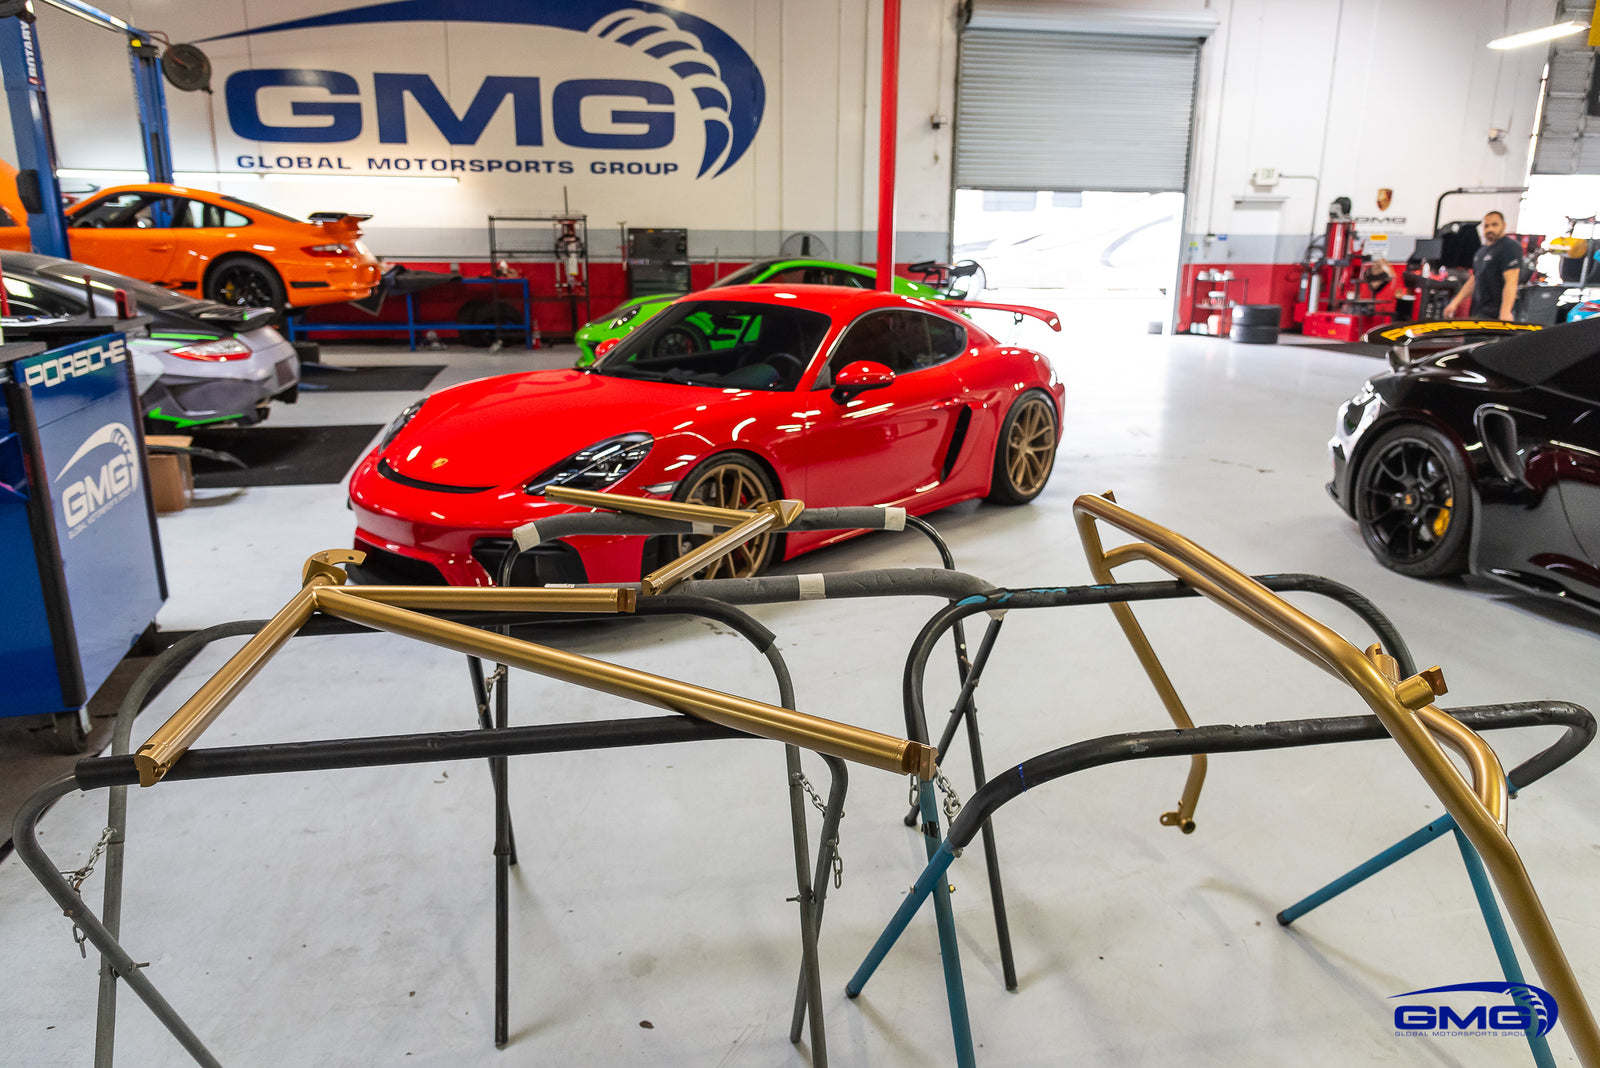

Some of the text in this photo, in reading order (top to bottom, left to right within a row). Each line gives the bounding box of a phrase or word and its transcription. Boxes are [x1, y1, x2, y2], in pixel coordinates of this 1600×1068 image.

[20, 20, 38, 78] ROTARY
[225, 68, 675, 150] GMG
[237, 155, 679, 175] GLOBAL MOTORSPORTS GROUP
[24, 339, 126, 388] PORSCHE
[62, 453, 130, 528] GMG
